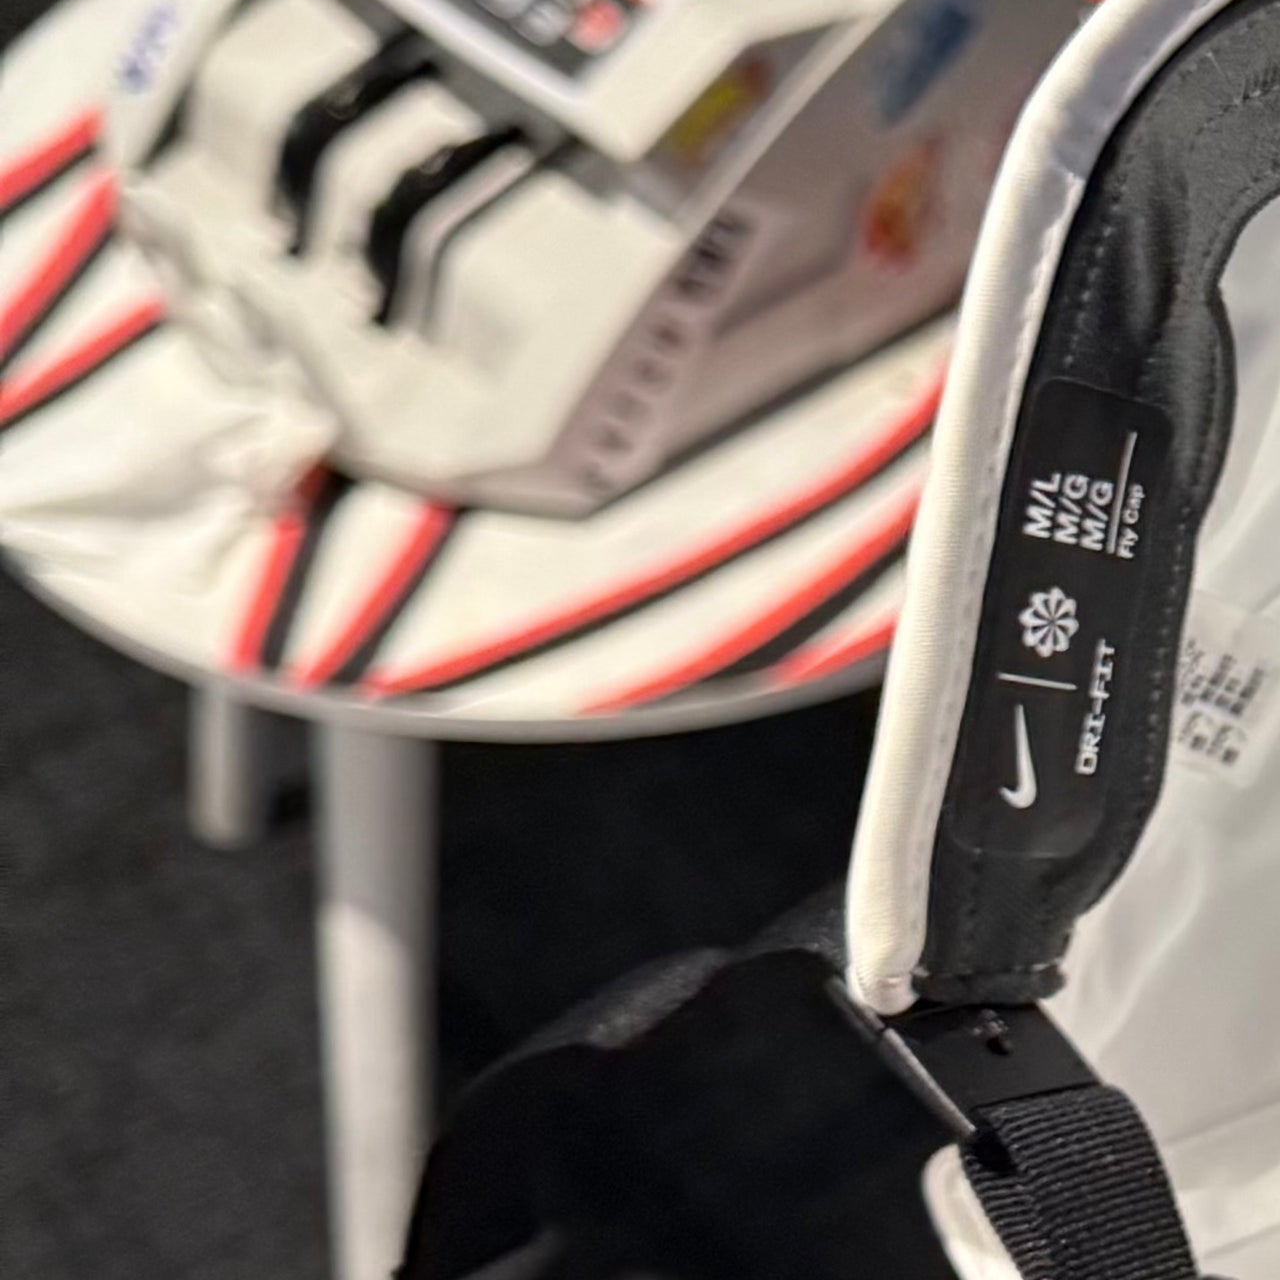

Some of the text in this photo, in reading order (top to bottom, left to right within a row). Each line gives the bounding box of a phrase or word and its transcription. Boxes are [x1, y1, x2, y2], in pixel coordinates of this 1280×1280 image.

[1022, 472, 1061, 539] M/L
[1052, 473, 1088, 545] M/G
[1079, 480, 1114, 552] M/G
[1116, 483, 1145, 559] Fly Cap
[1074, 637, 1115, 775] DRI-FIT
